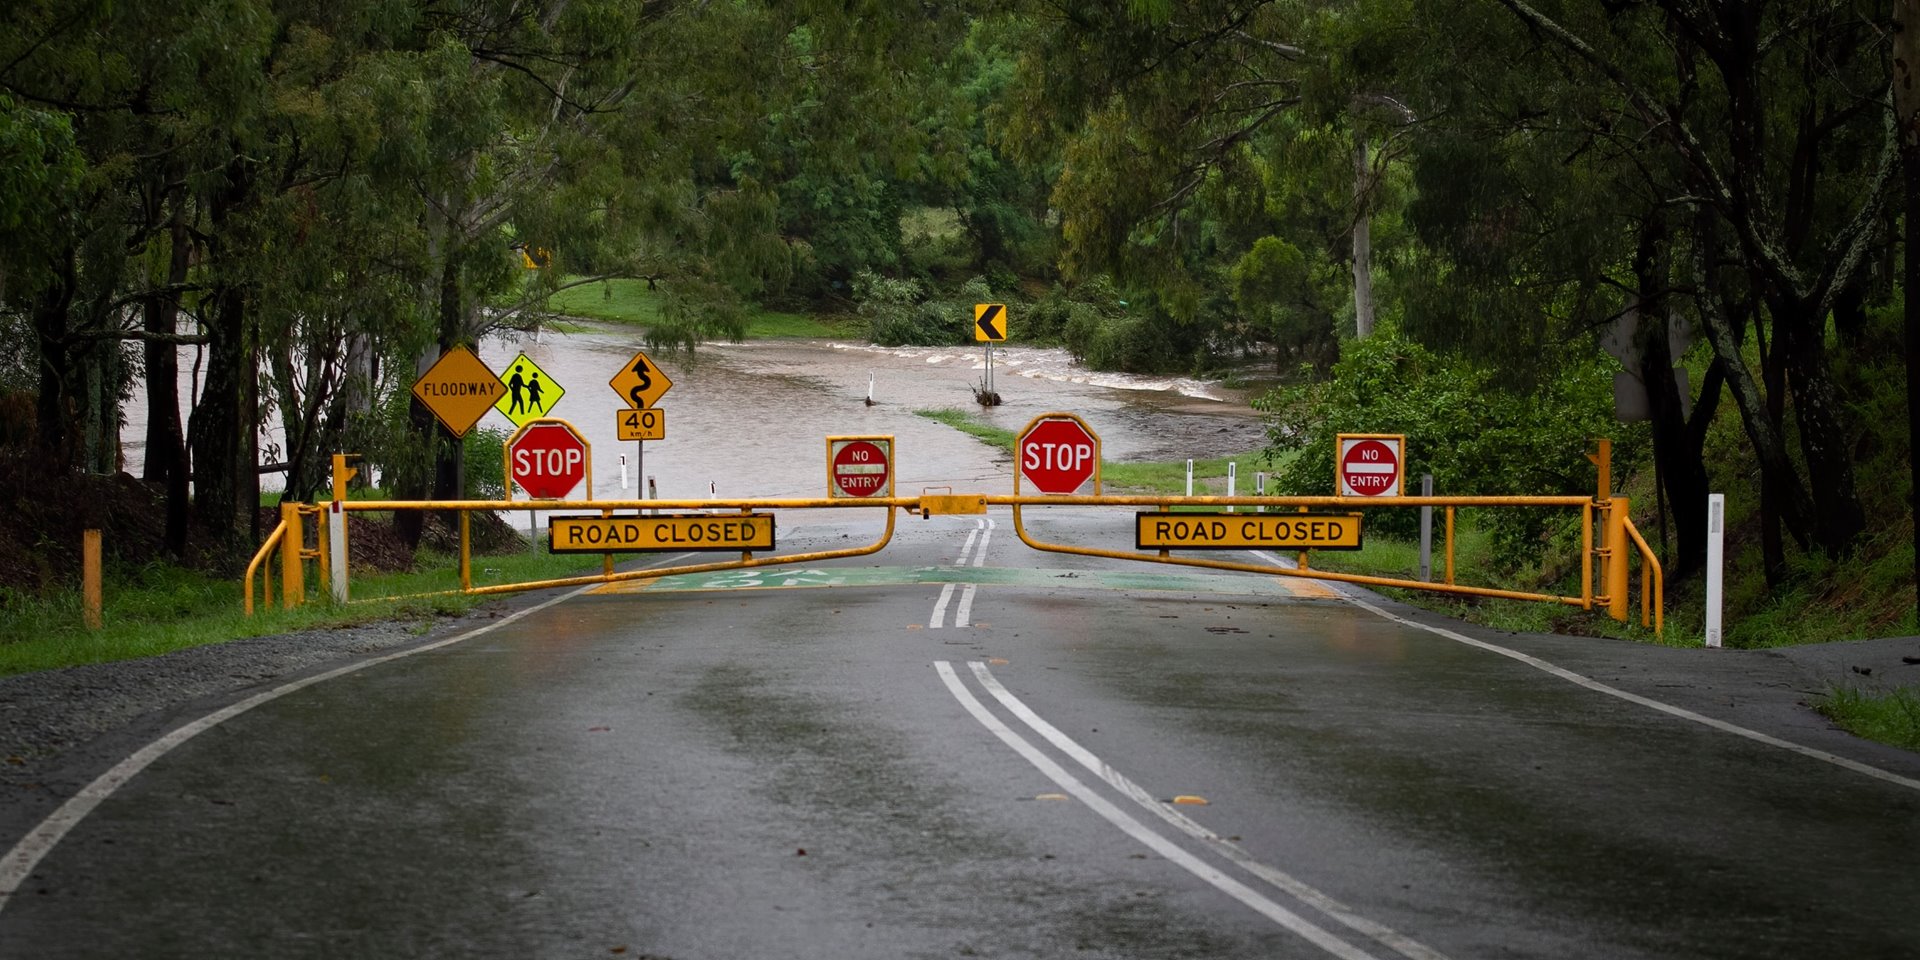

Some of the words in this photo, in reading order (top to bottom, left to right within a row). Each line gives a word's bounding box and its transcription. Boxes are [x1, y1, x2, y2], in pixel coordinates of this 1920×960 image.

[424, 383, 496, 396] FLOODWAY
[625, 412, 655, 429] 40
[515, 448, 581, 476] STOP
[852, 450, 869, 462] NO
[1024, 442, 1091, 471] STOP
[1362, 449, 1379, 461] NO
[841, 477, 880, 488] ENTRY
[1350, 475, 1389, 487] ENTRY
[569, 525, 640, 544] ROAD
[654, 523, 756, 543] CLOSED
[1156, 521, 1227, 541] ROAD
[1241, 521, 1343, 541] CLOSED
